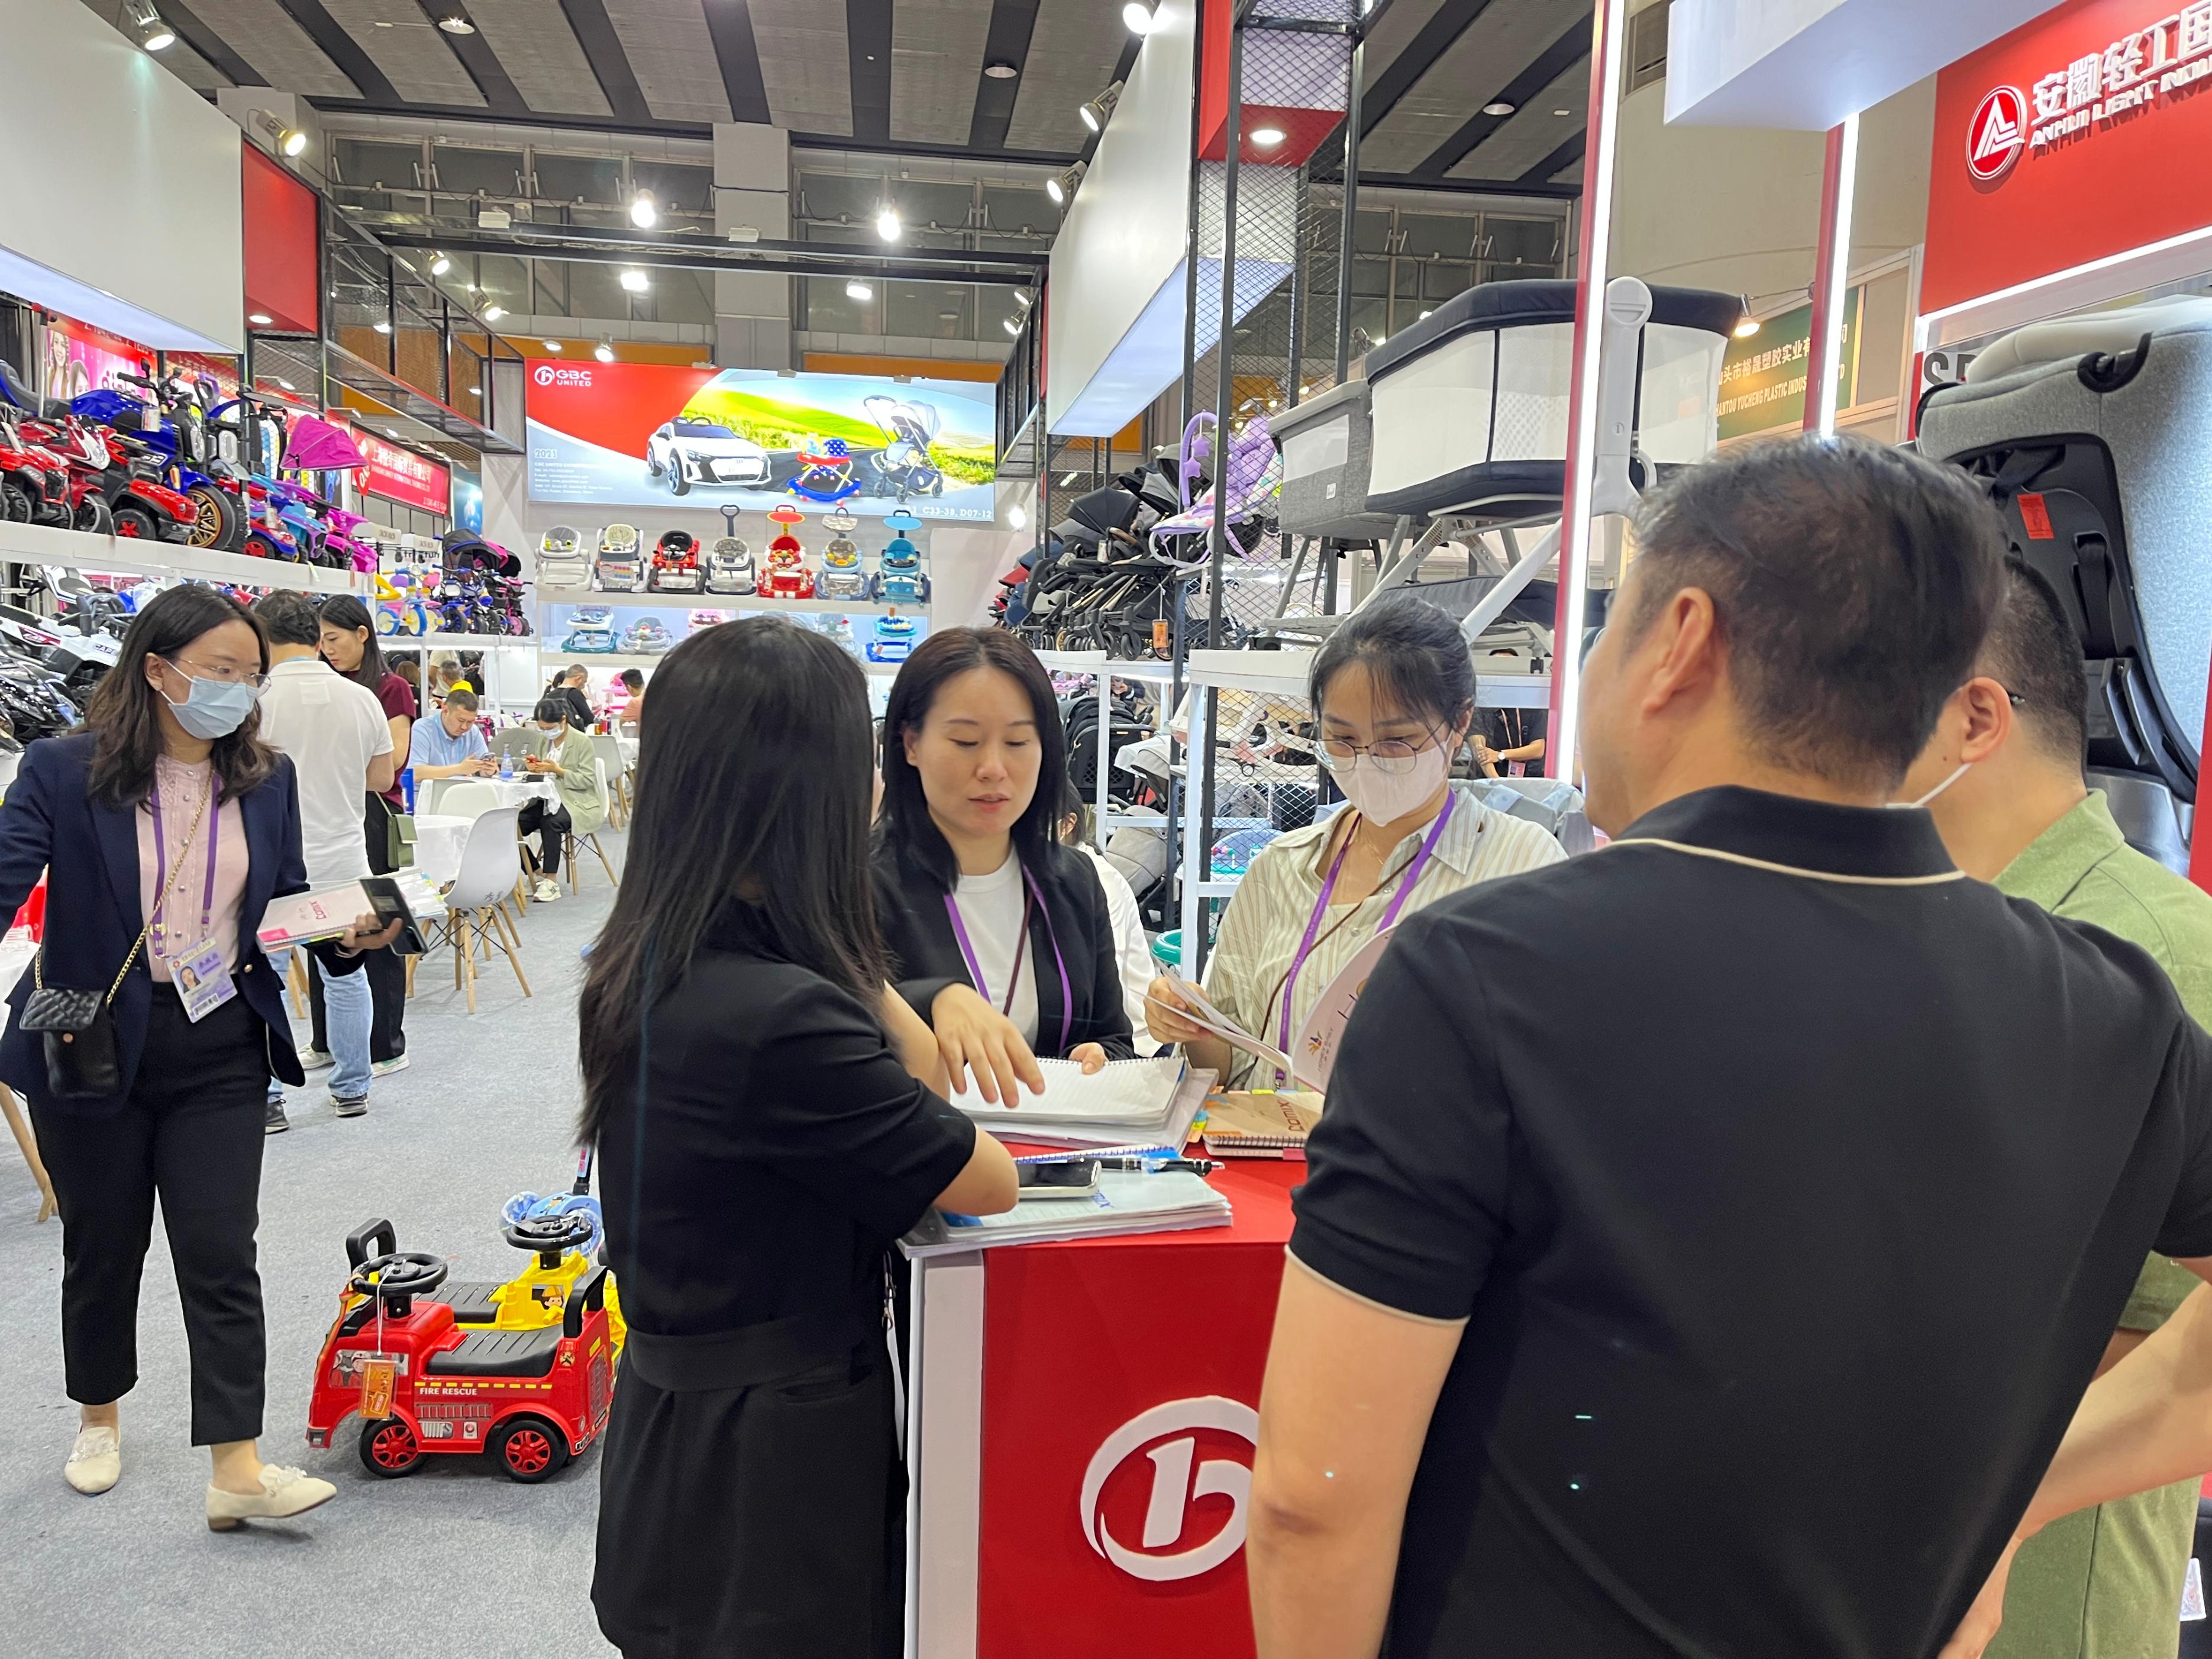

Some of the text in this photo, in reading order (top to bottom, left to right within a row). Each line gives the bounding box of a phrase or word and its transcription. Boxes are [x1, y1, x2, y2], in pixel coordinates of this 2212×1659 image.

[2029, 109, 2090, 149] ANHUI
[2092, 79, 2159, 121] LIGHT
[556, 370, 592, 380] GBC
[1737, 389, 1764, 411] YUCHENG
[1764, 382, 1788, 403] PLASTIC
[960, 509, 992, 518] D07-12
[1277, 1099, 1306, 1132] COMIX
